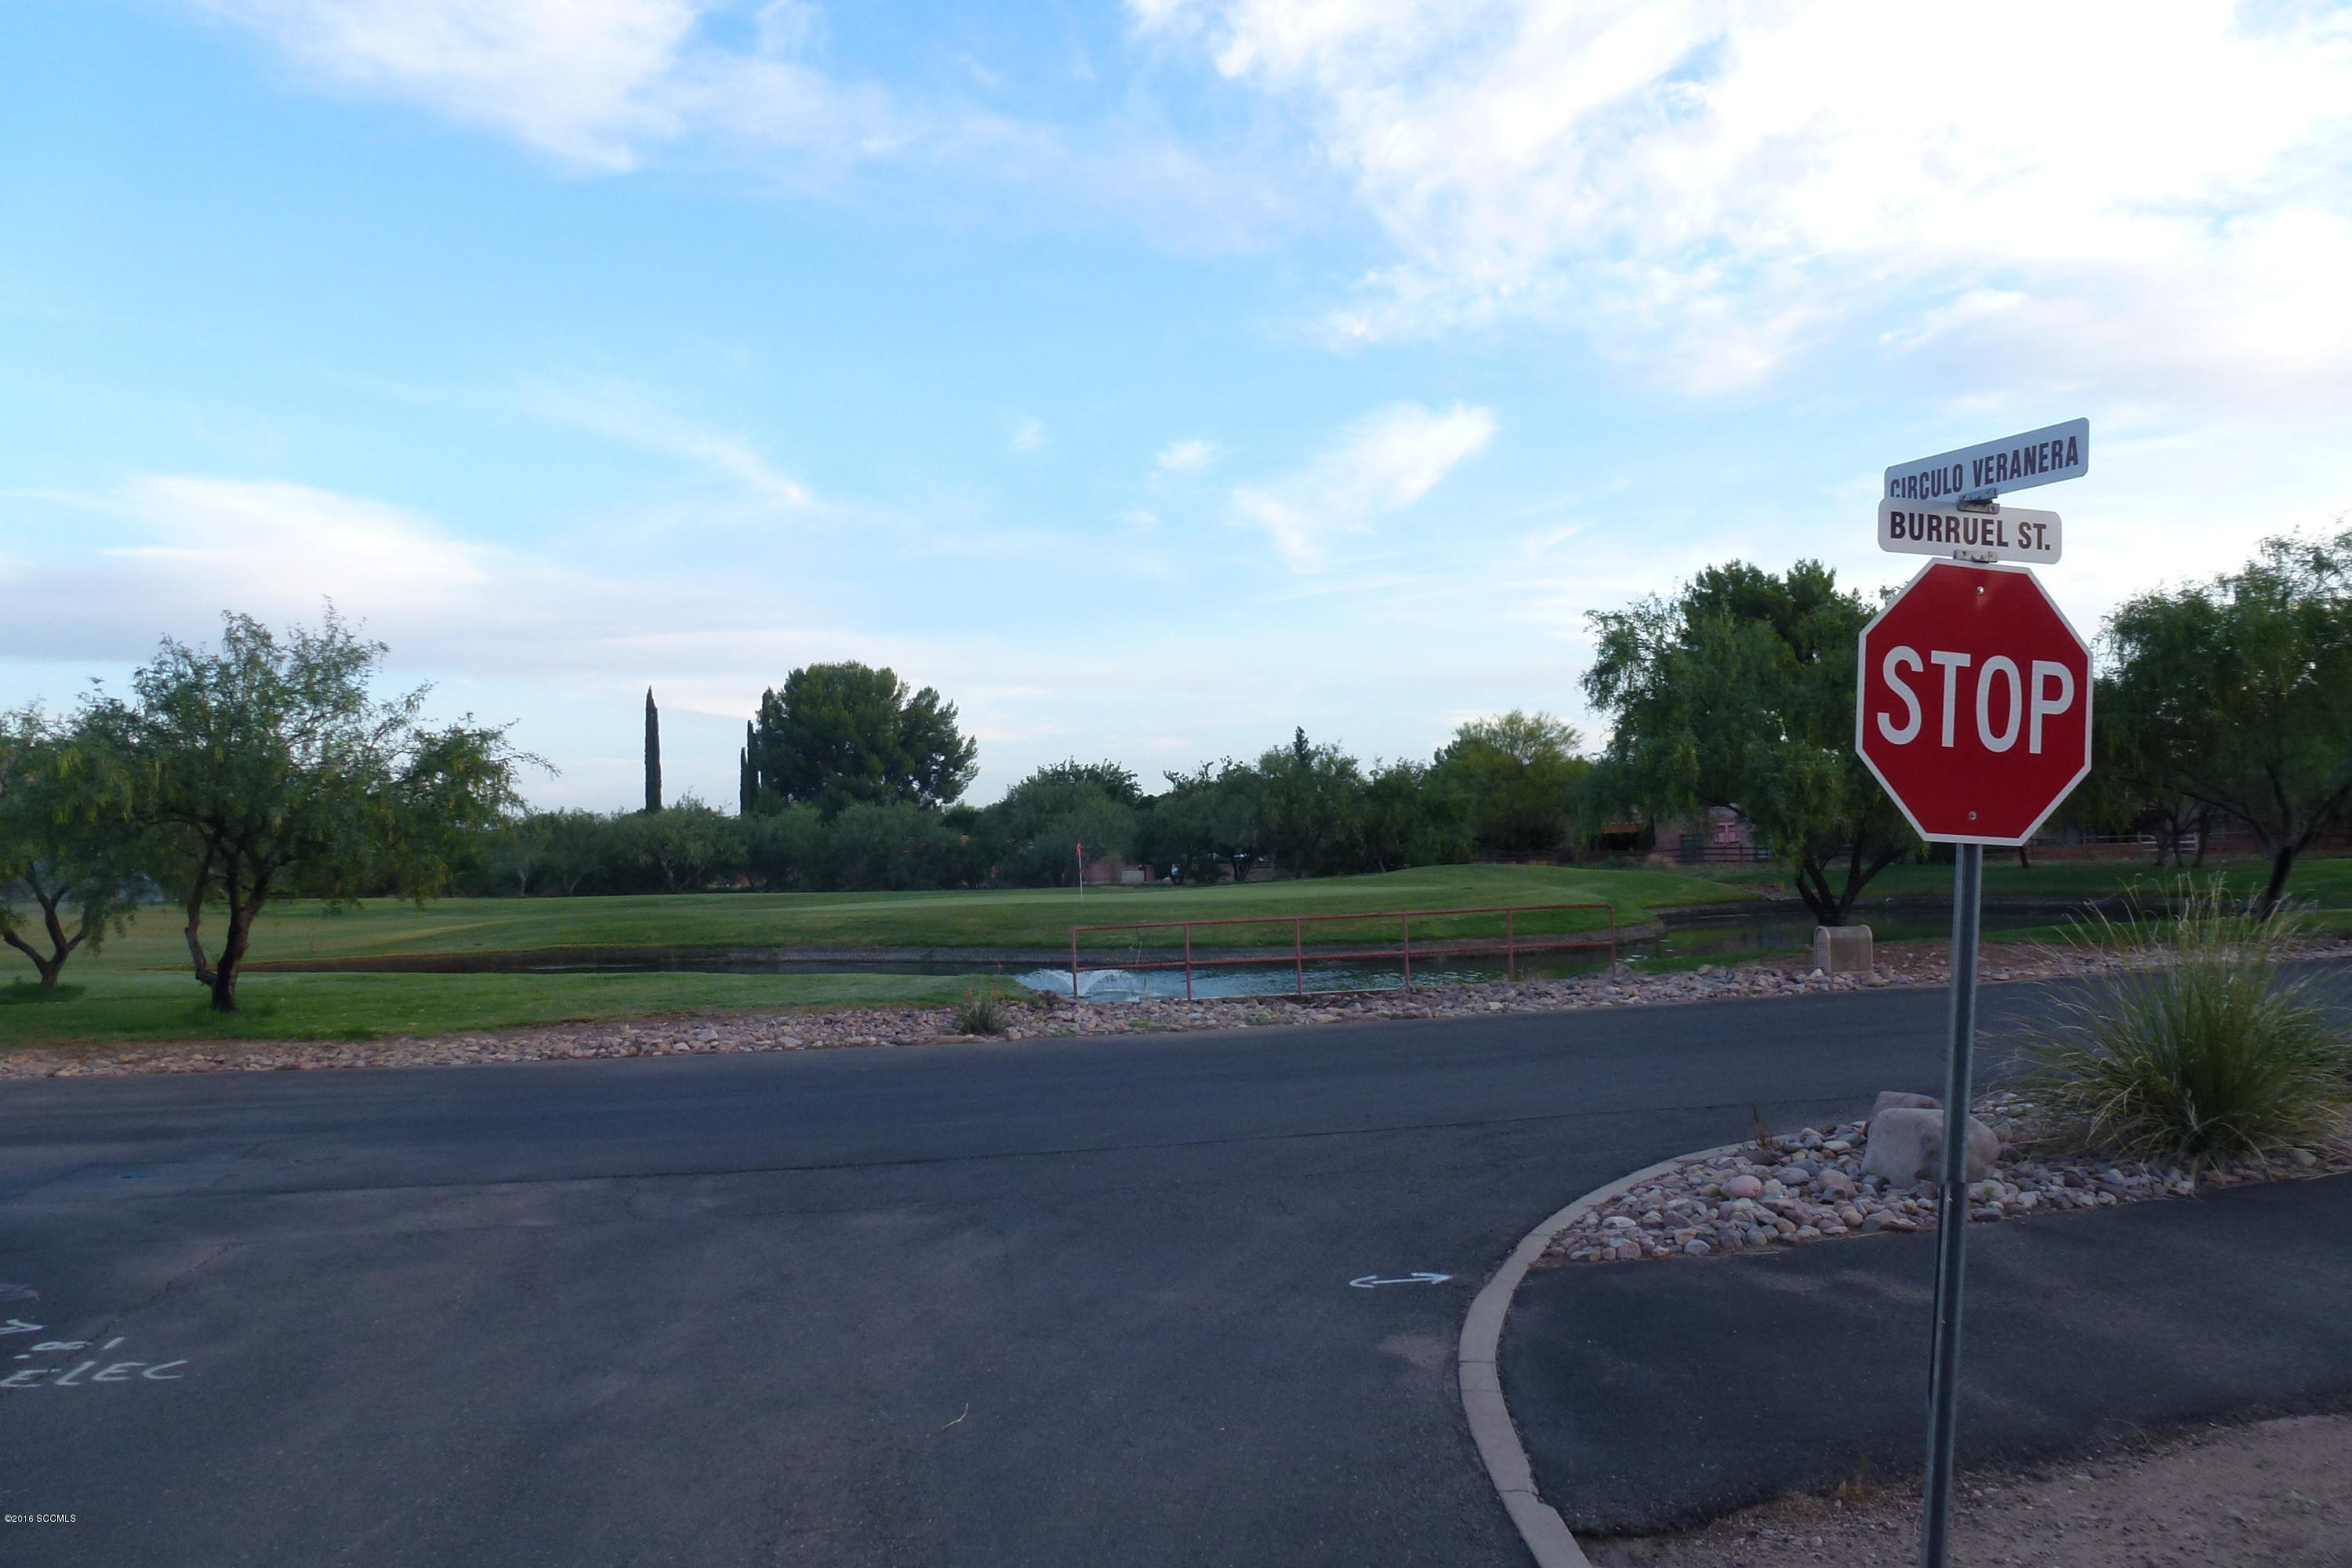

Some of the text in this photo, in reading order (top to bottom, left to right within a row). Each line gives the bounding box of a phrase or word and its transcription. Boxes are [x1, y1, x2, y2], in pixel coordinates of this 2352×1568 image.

[1890, 436, 2079, 500] CIRCULO VERANERA
[1890, 511, 2051, 550] BURRUEL ST.
[1877, 645, 2074, 754] STOP
[0, 1359, 188, 1388] ELEC
